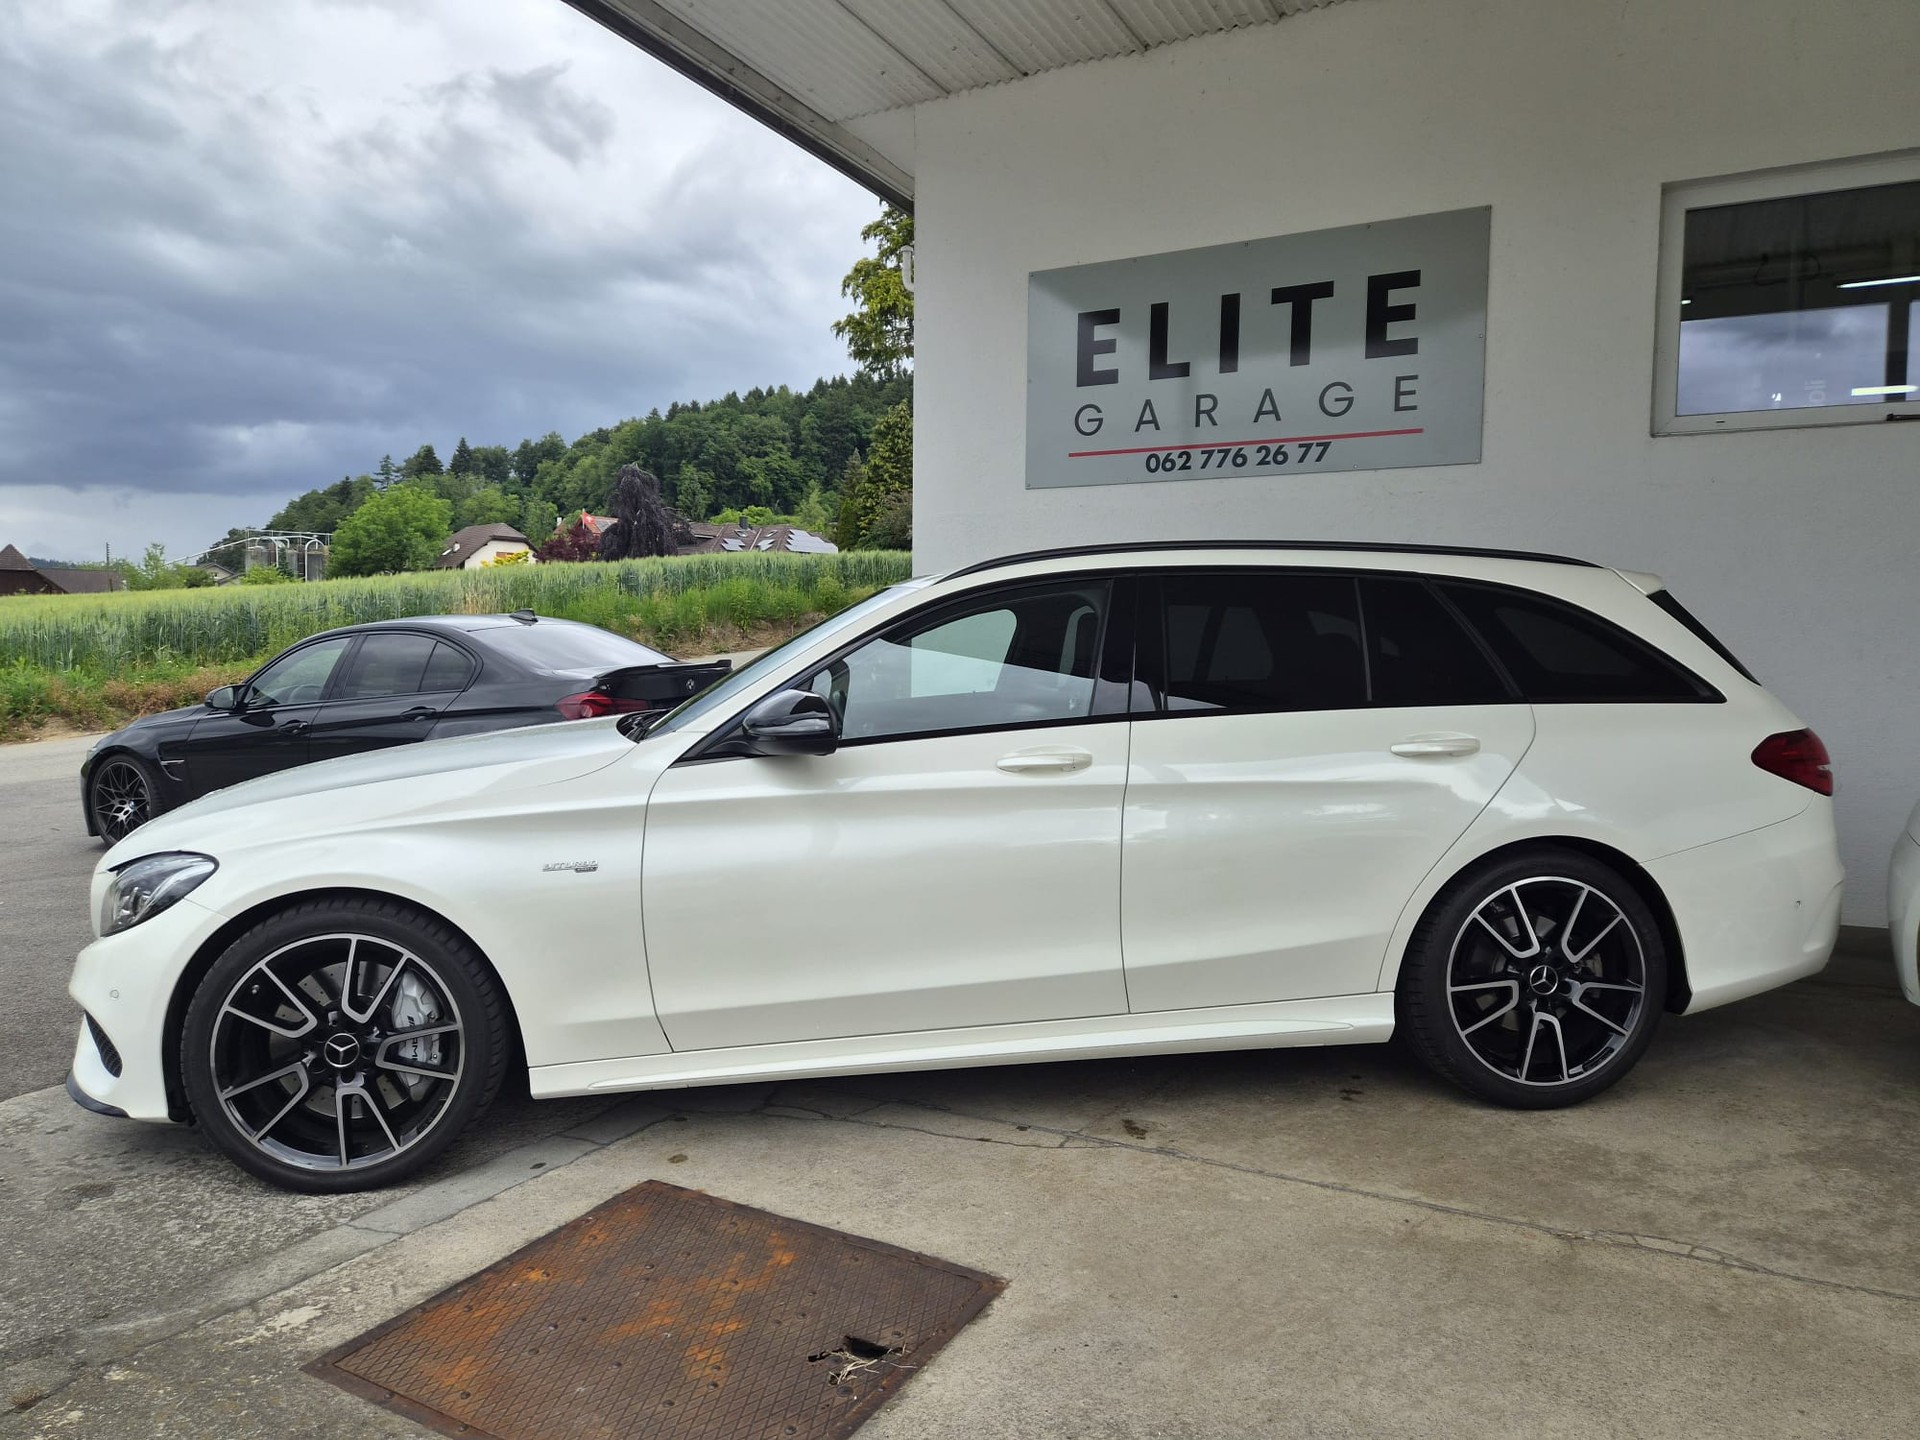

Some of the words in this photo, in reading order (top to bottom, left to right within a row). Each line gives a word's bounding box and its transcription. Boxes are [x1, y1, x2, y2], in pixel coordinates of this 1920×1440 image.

[1076, 269, 1421, 388] ELITE
[1074, 374, 1419, 437] GARAGE
[1145, 451, 1192, 473] 062
[1200, 447, 1248, 469] 776
[1256, 444, 1289, 466] 26
[1297, 441, 1332, 463] 77
